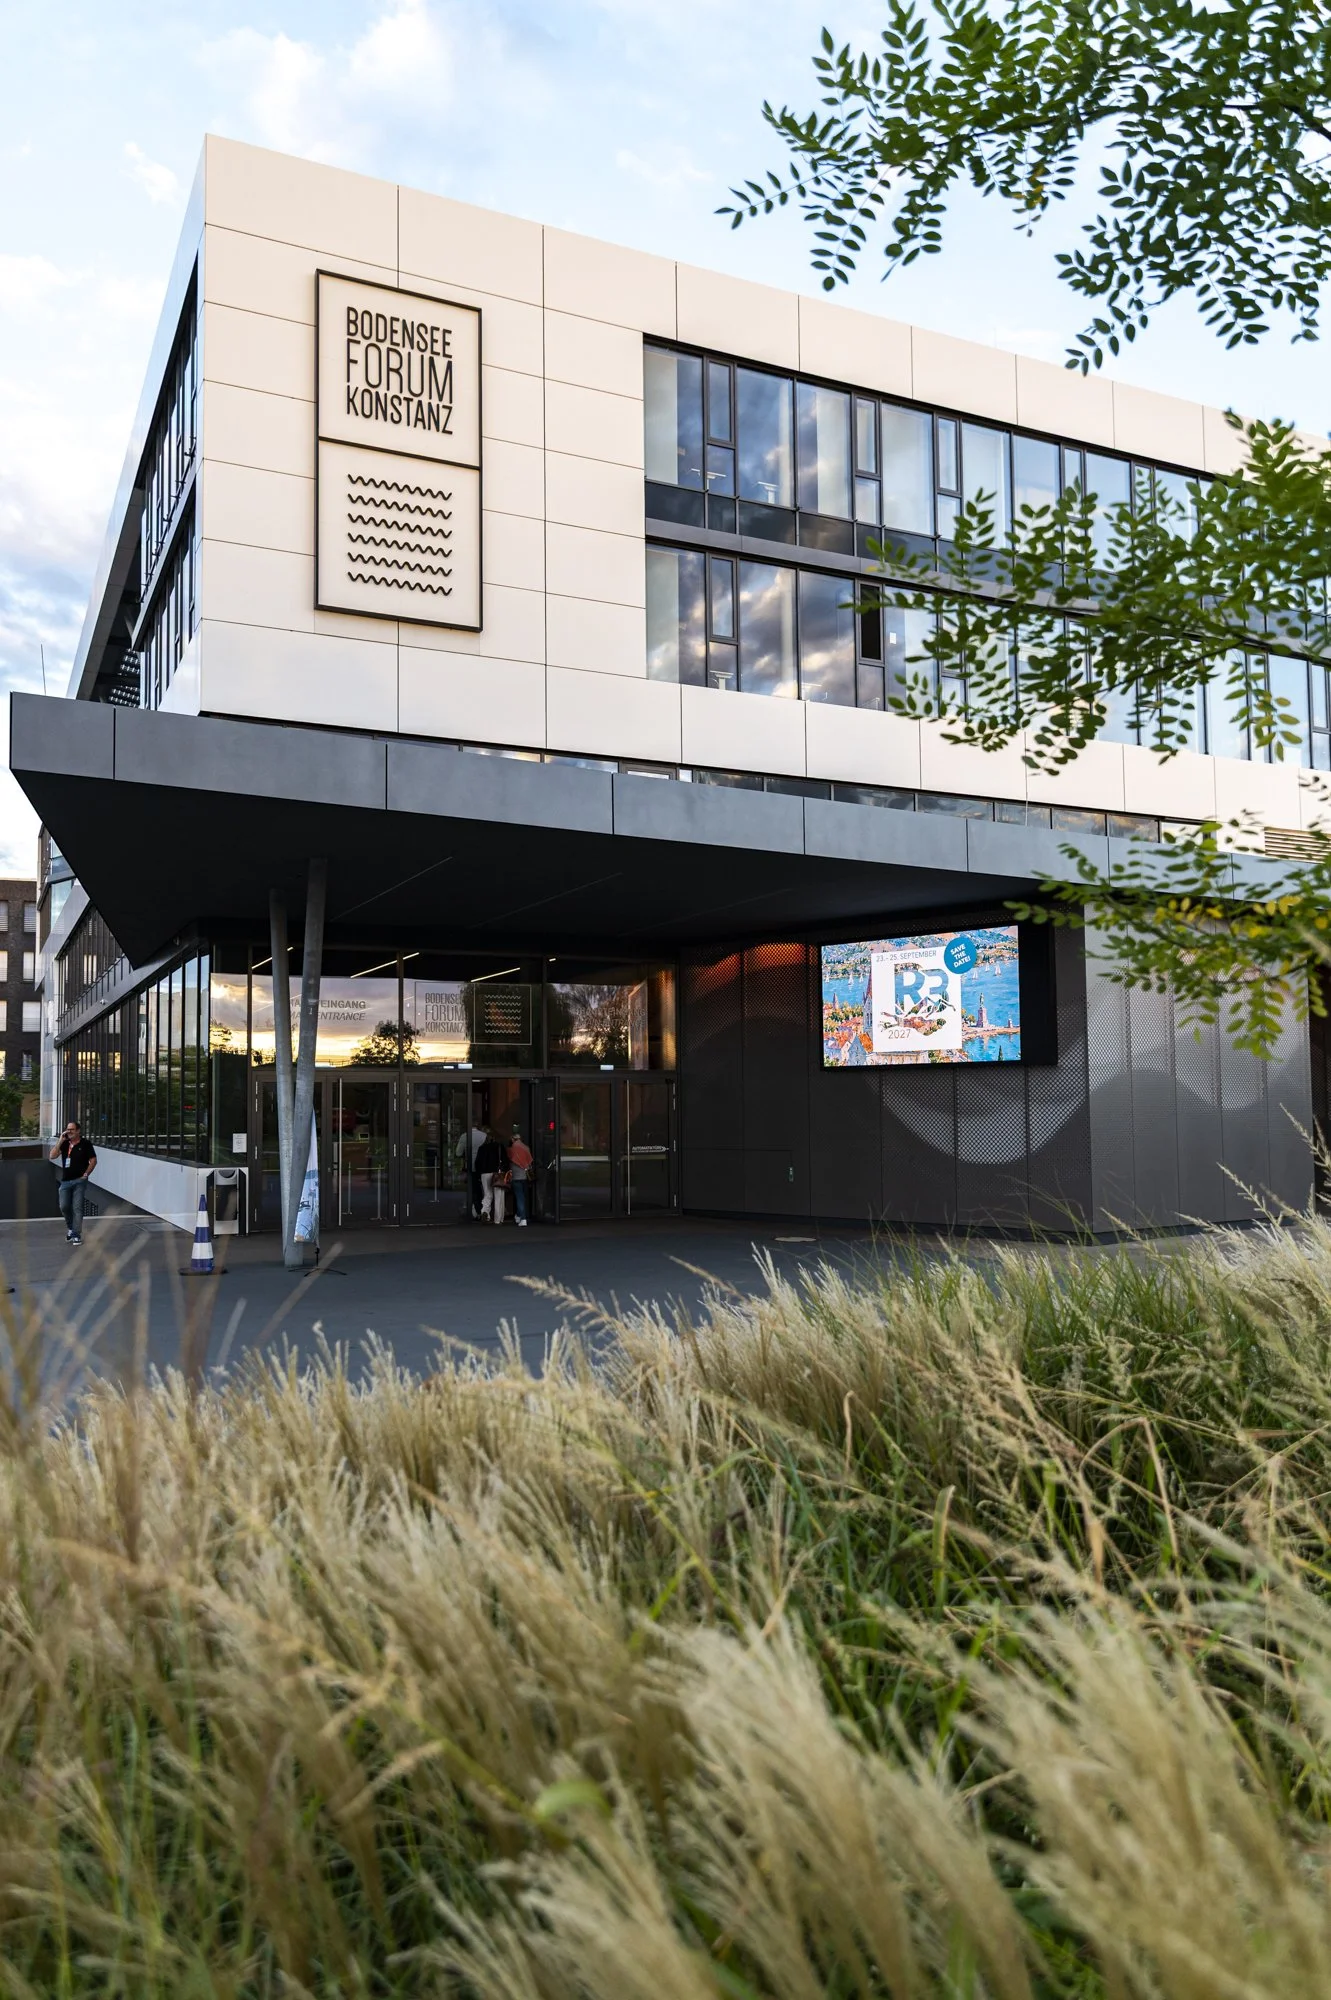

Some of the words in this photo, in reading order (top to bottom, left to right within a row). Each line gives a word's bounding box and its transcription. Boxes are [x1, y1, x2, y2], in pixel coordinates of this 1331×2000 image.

[347, 306, 452, 359] BODENSEE
[347, 338, 453, 404] FORUM
[347, 385, 453, 435] KONSTANZ
[900, 949, 937, 960] SEPTEMBER
[950, 944, 966, 955] SAVE
[954, 950, 966, 960] THE
[953, 955, 971, 967] DATE!
[425, 1004, 465, 1021] FORUM
[425, 1021, 464, 1033] KONSTANZ
[888, 1029, 911, 1039] 2027
